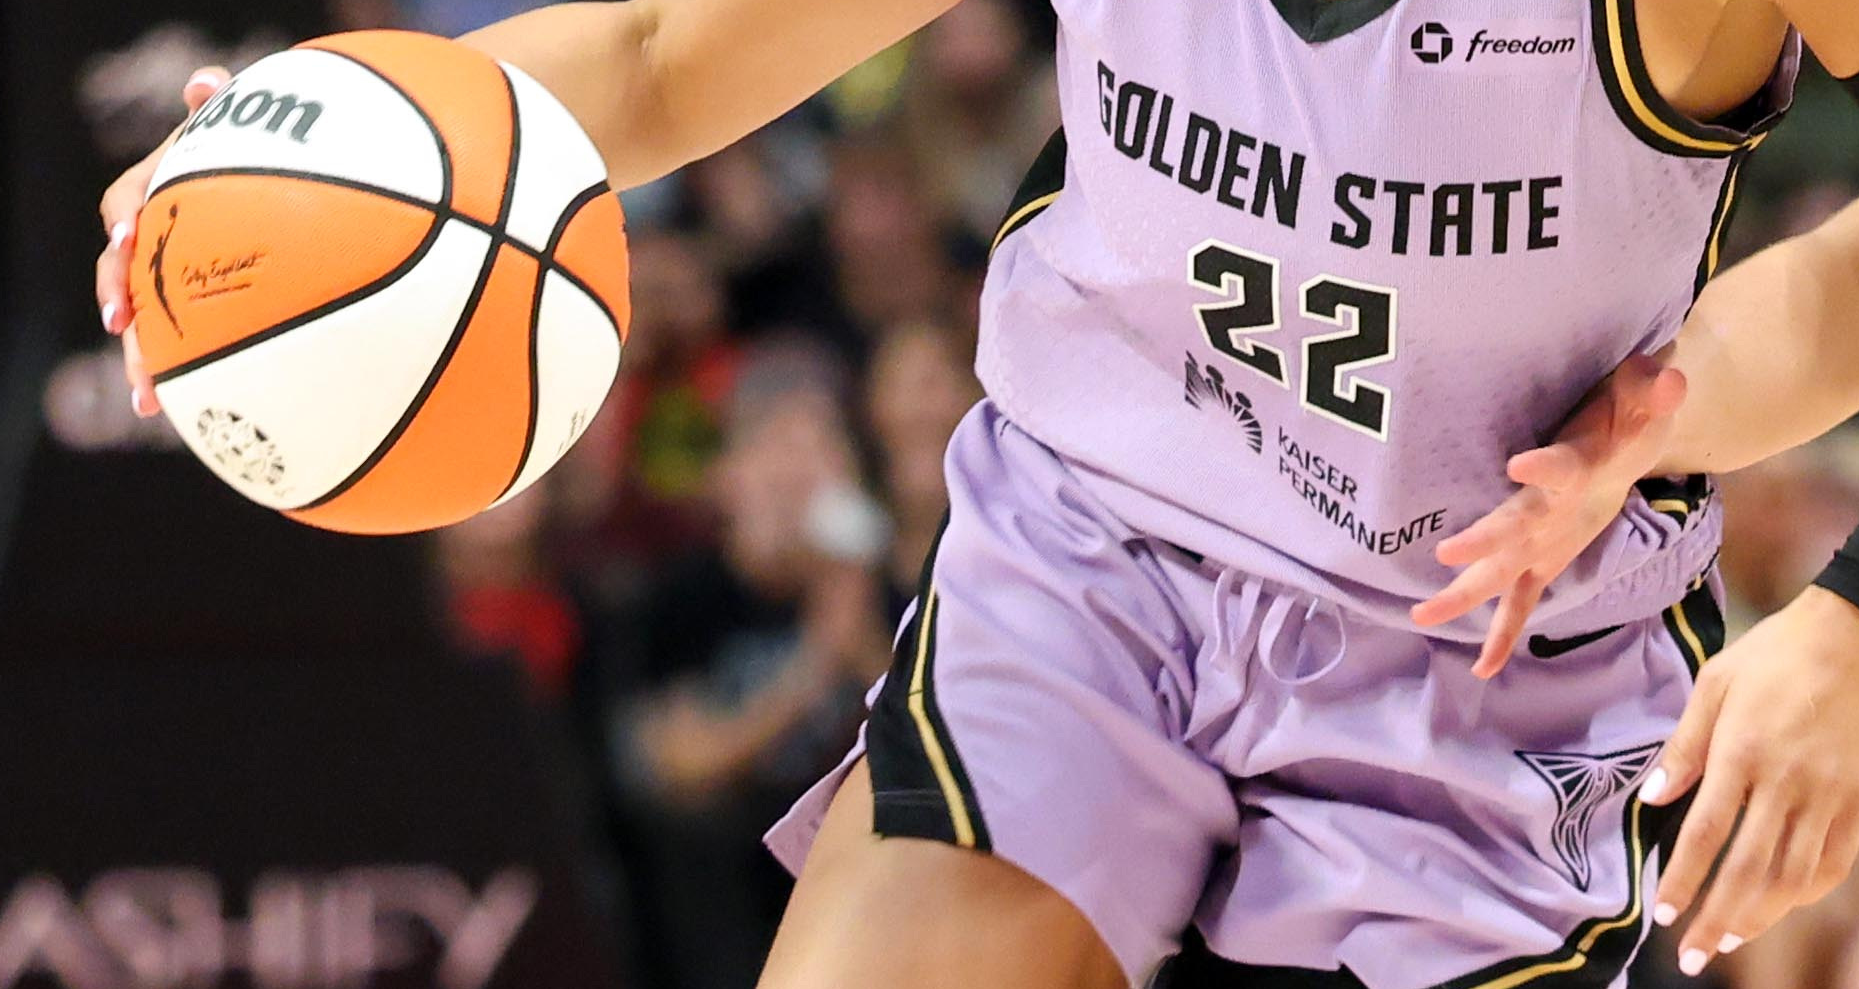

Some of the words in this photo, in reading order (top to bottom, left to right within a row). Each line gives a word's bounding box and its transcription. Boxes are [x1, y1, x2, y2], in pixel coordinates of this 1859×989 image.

[1466, 29, 1575, 61] freedom
[178, 79, 325, 145] lson
[1097, 59, 1306, 230] GOLDEN
[1330, 171, 1564, 258] STATE
[1187, 239, 1398, 441] 22
[1277, 426, 1359, 504] KAISER
[1278, 457, 1448, 556] PERMANENTE
